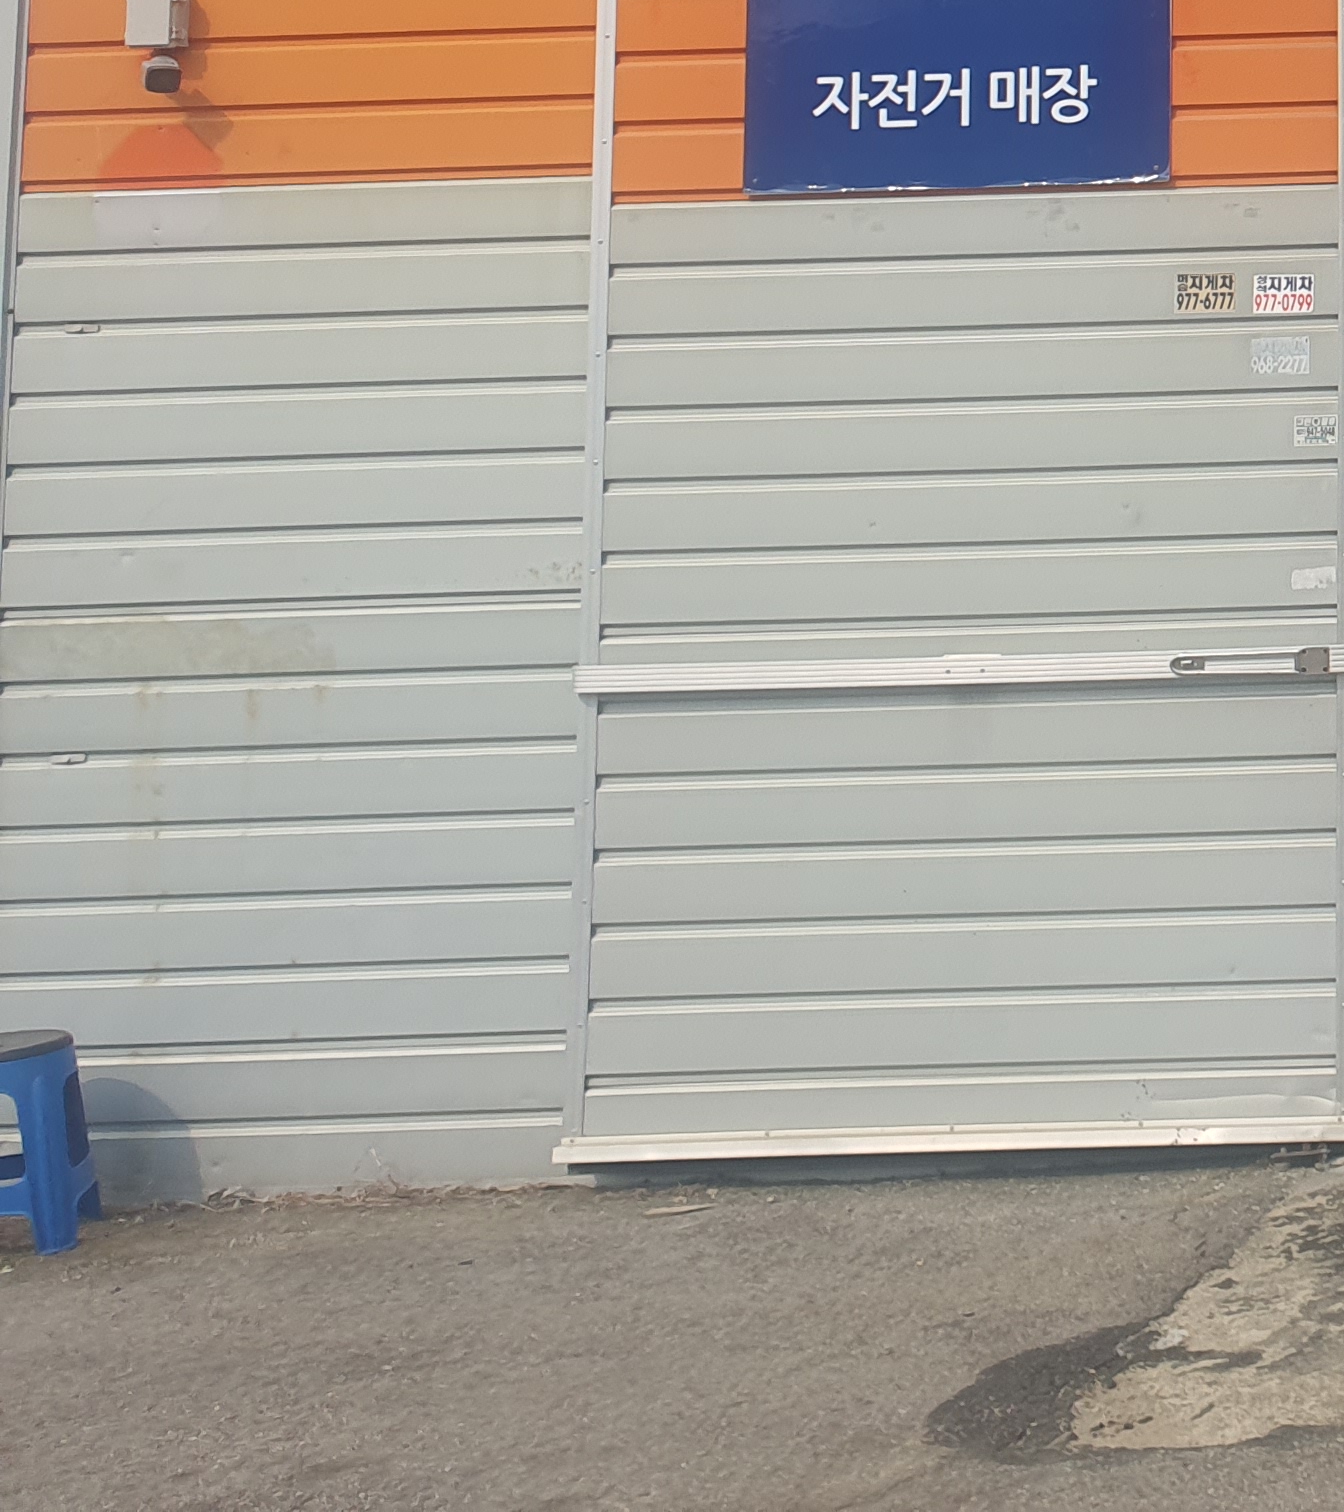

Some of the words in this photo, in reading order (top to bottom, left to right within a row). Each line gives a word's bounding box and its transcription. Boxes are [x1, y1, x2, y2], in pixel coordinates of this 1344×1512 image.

[812, 67, 971, 131] 자전거
[989, 64, 1097, 124] 매장
[1189, 274, 1234, 291] 지게차
[1268, 276, 1313, 292] 지게차
[1176, 292, 1234, 310] 977-6777
[1255, 294, 1312, 311] 977-0799
